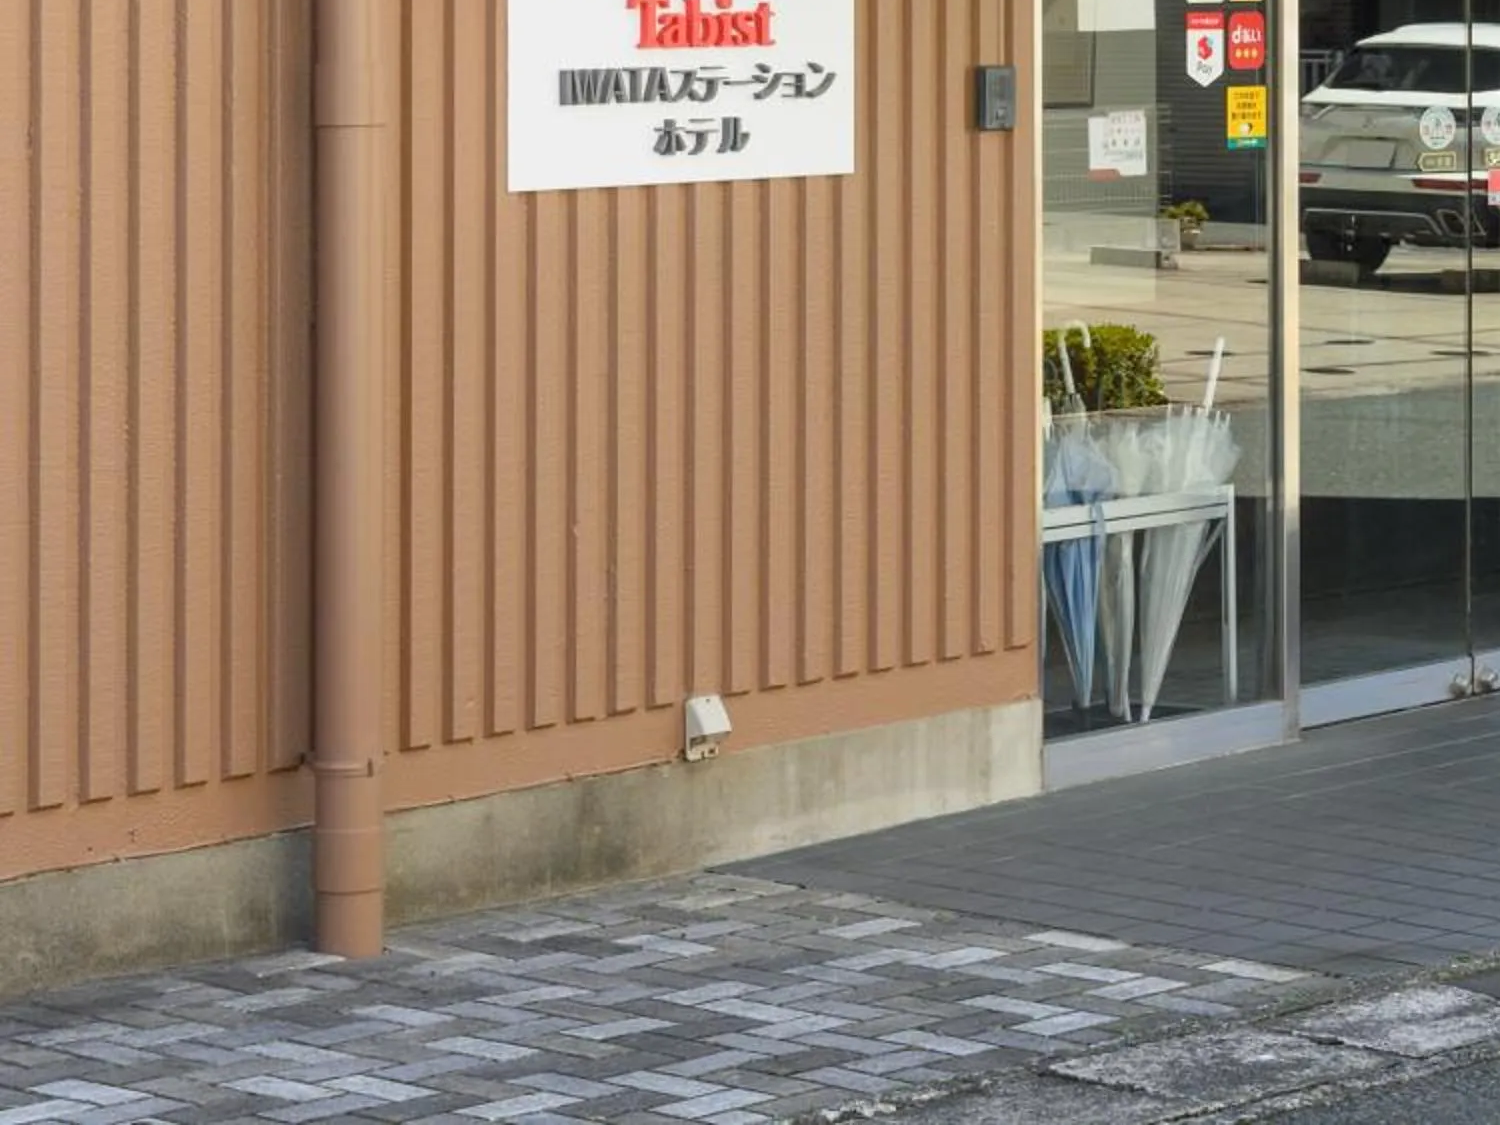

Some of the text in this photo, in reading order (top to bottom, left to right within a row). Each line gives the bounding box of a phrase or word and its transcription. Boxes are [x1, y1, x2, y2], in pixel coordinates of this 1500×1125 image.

[558, 62, 837, 106] IWATAステーション
[652, 117, 751, 156] ホテル
